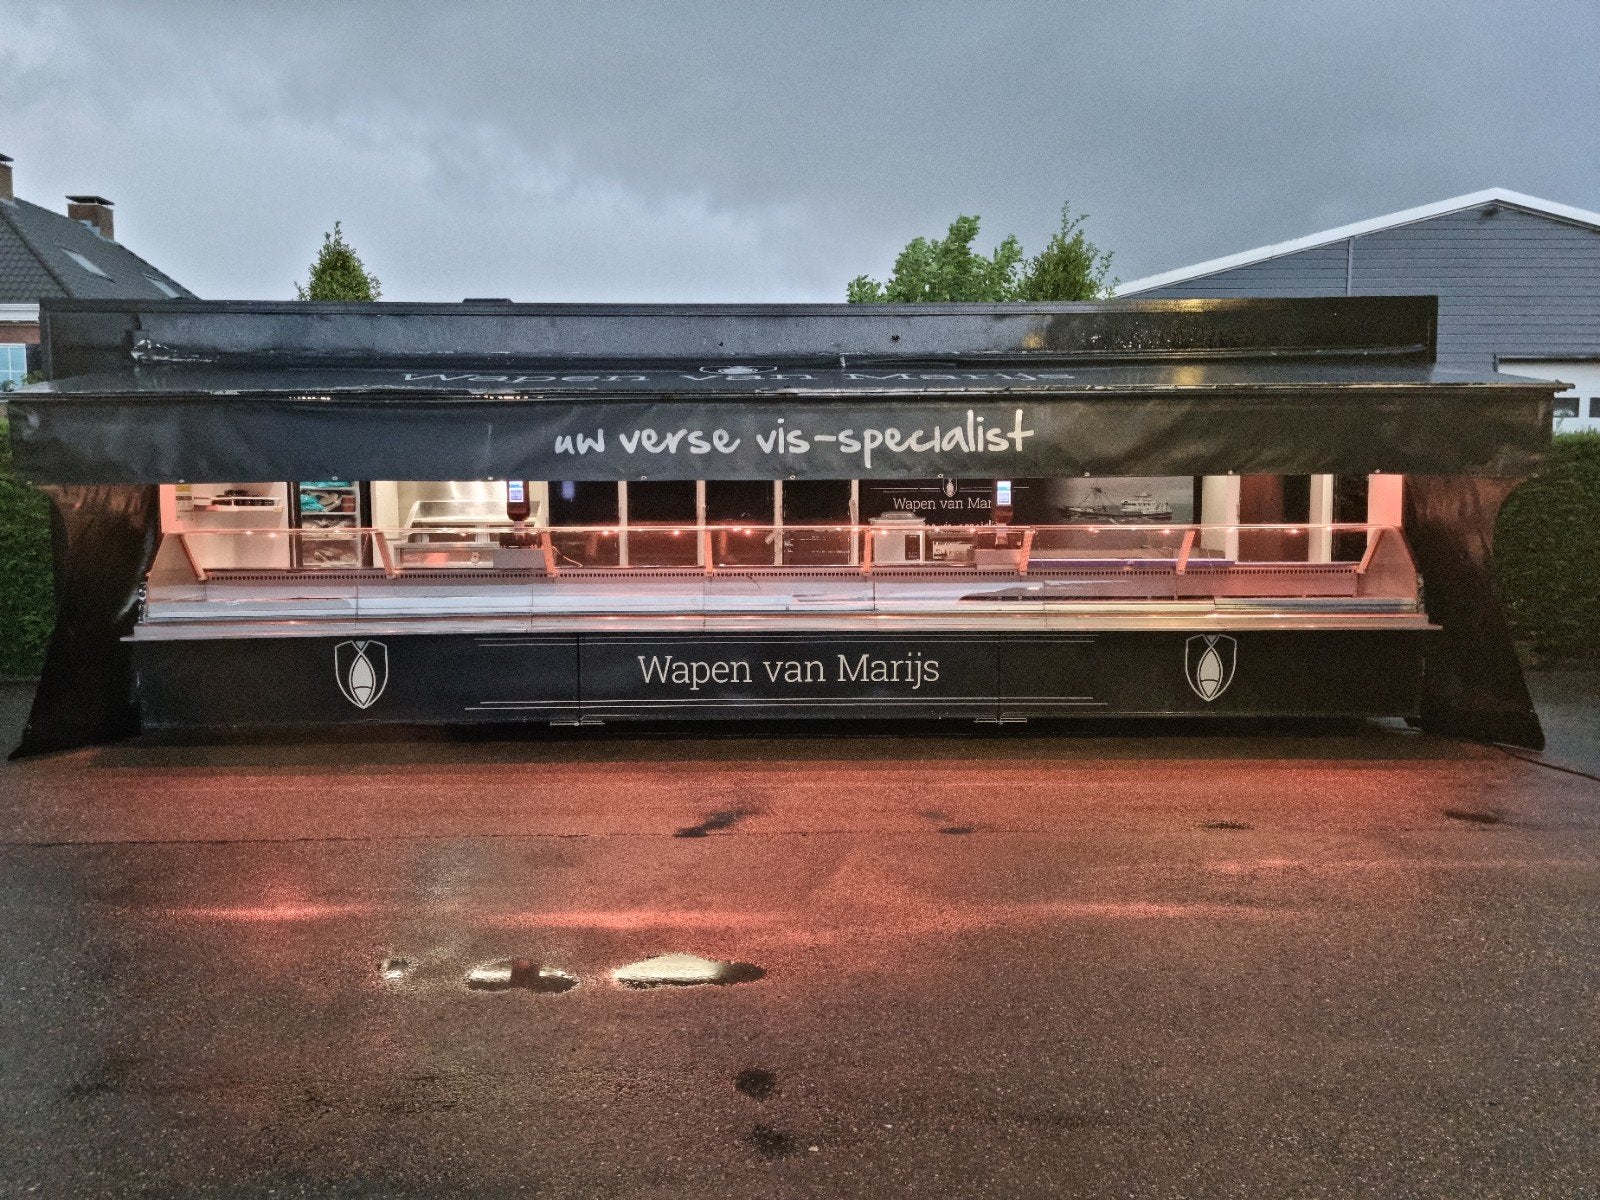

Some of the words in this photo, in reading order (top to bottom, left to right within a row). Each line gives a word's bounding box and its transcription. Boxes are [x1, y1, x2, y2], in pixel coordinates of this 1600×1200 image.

[402, 373, 650, 383] Wapen
[554, 428, 606, 455] uw
[619, 428, 741, 454] verse
[755, 409, 1035, 469] vis-specialist
[893, 497, 937, 511] Wapen
[940, 499, 963, 509] van
[968, 497, 992, 509] Mar
[637, 655, 753, 691] Wapen
[763, 658, 827, 683] van
[837, 652, 940, 690] Marijs
